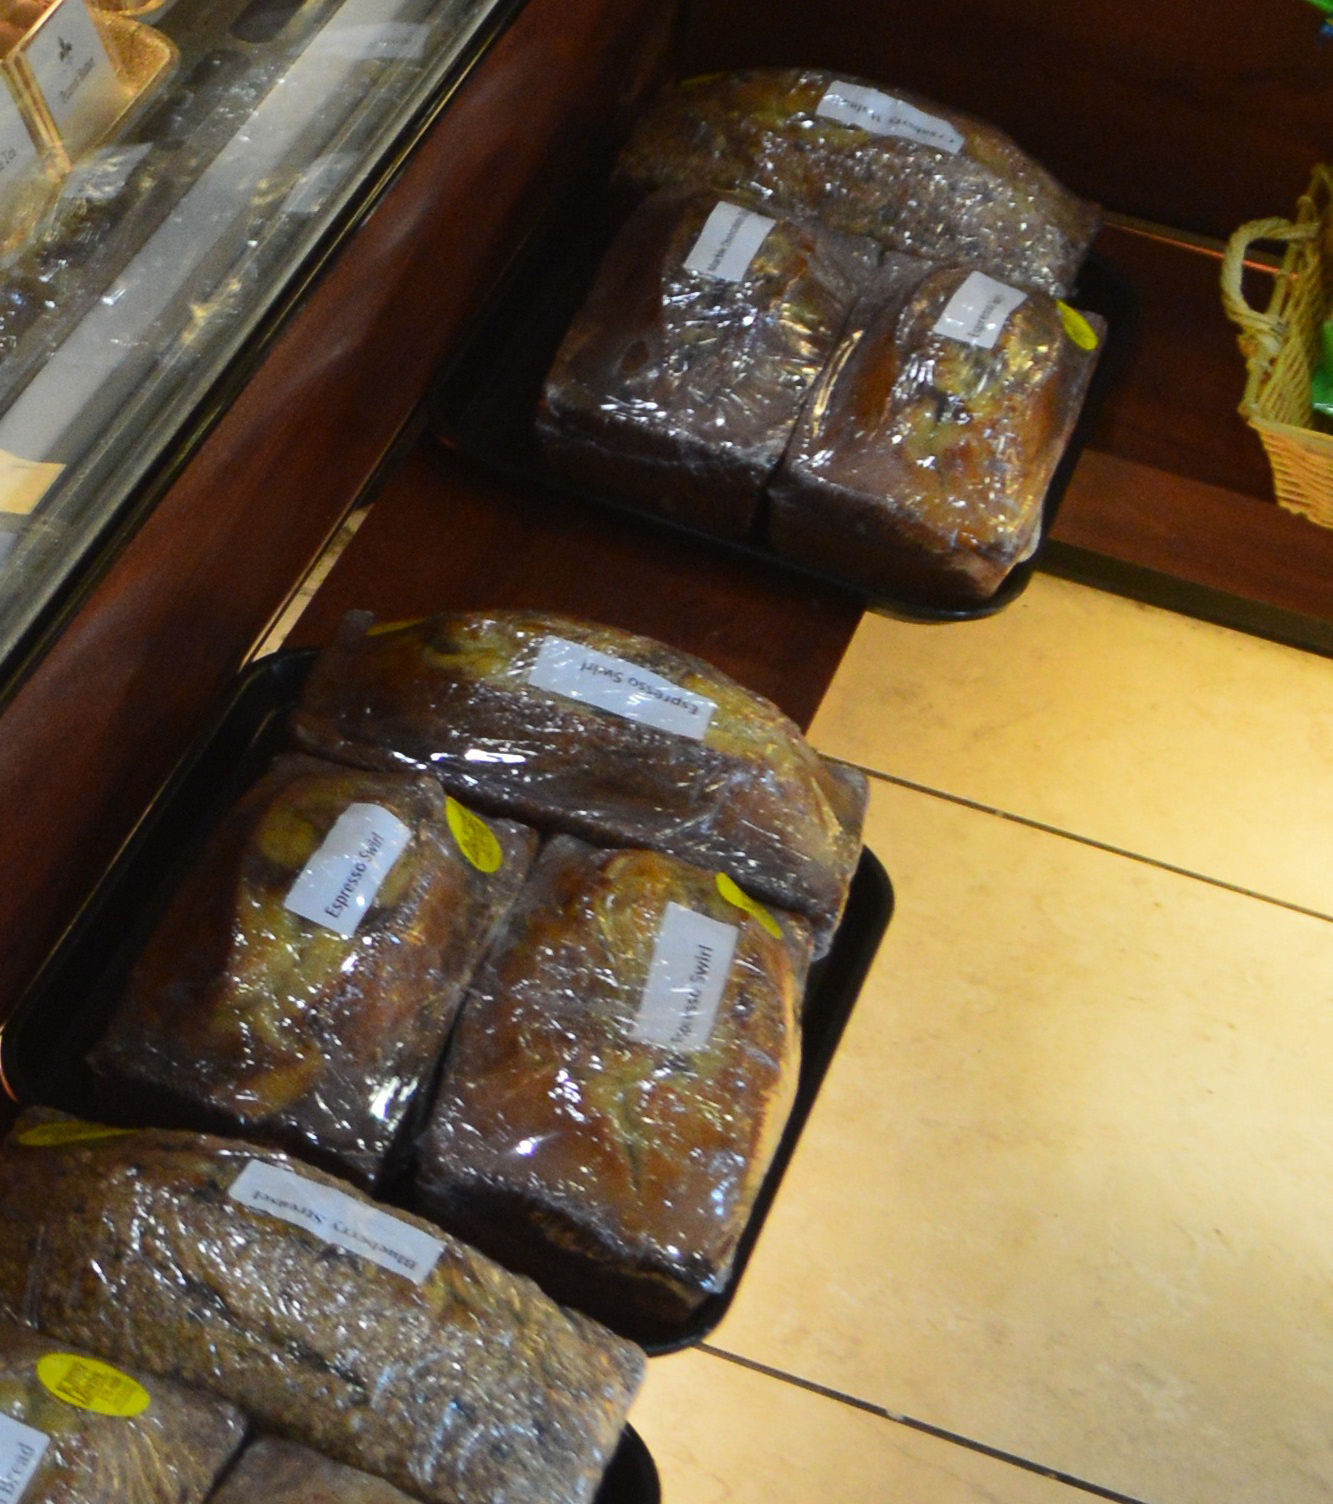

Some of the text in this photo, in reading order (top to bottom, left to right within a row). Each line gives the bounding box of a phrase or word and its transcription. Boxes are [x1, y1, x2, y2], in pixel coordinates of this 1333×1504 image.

[580, 662, 699, 716] Espresso Swirl
[324, 831, 385, 920] Espresso Swirl
[690, 943, 714, 984] Swirl
